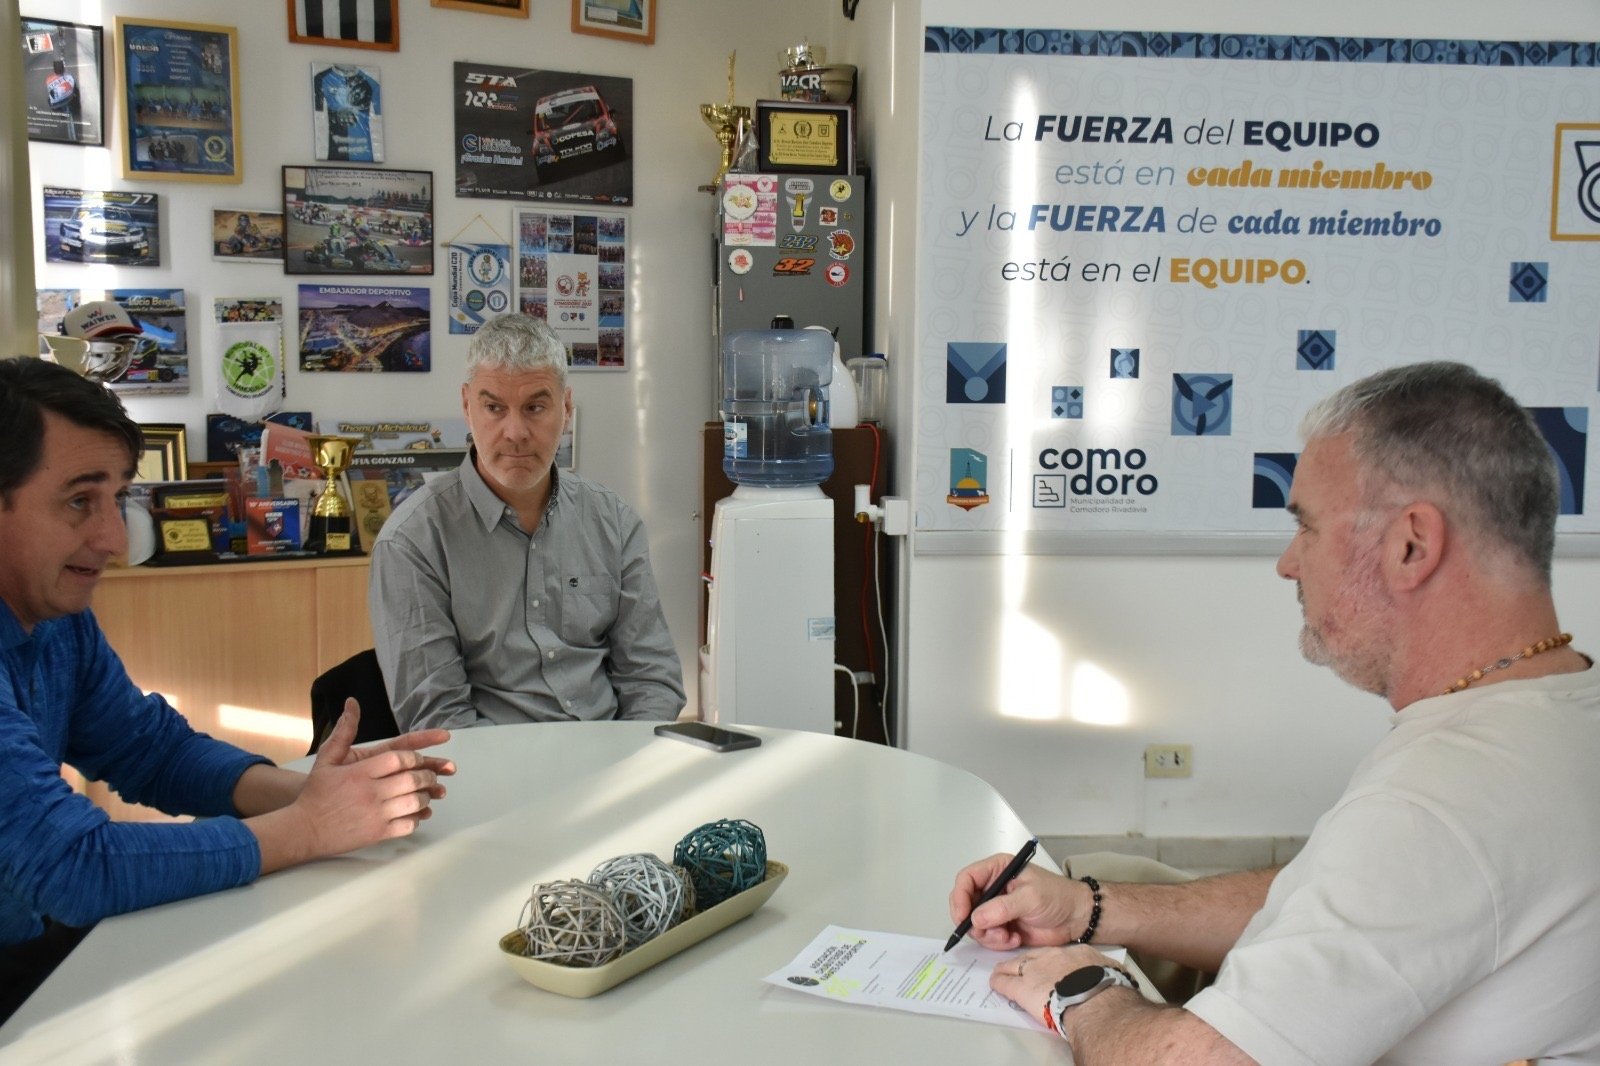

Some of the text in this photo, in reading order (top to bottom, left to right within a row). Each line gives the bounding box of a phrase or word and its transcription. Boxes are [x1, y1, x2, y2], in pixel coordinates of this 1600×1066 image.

[984, 115, 1380, 152] La FUERZA del EQUIPO
[1055, 159, 1434, 191] está en cada miembro
[130, 194, 154, 206] 77
[956, 203, 1442, 238] y la FUERZA de cada miembro
[773, 258, 816, 272] 32
[1001, 255, 1310, 290] está en el EQUIPO.
[319, 287, 412, 297] EMBAJADOR DEPORTIVO
[338, 422, 375, 434] Thomy
[371, 456, 415, 465] GONZALO
[1038, 448, 1147, 470] como
[1070, 470, 1158, 495] doro
